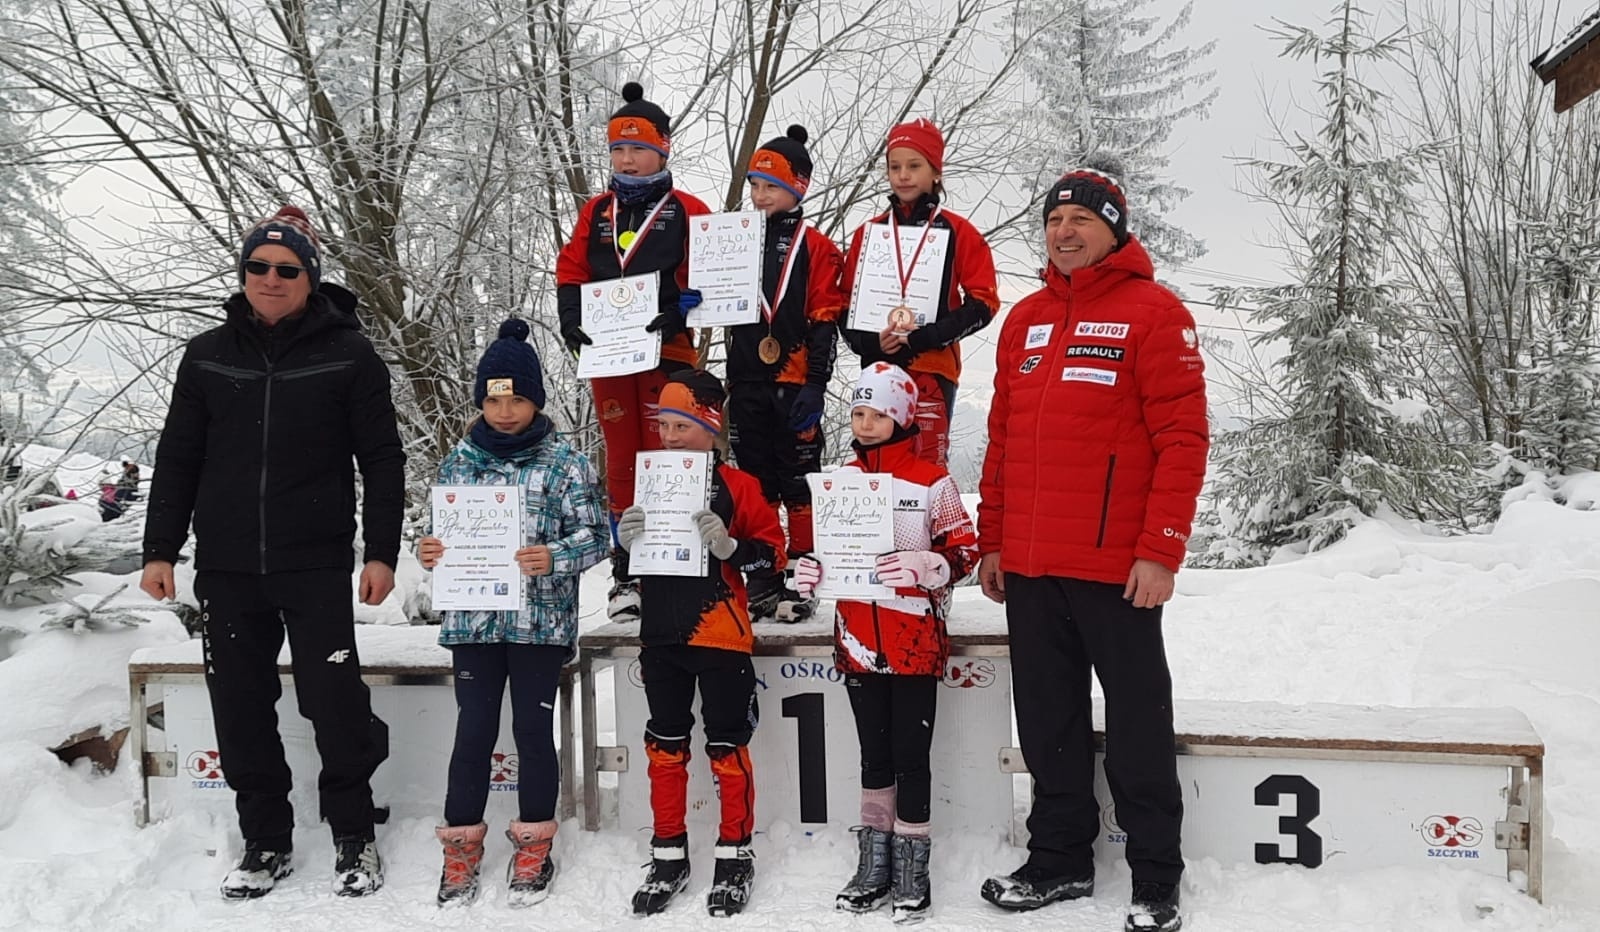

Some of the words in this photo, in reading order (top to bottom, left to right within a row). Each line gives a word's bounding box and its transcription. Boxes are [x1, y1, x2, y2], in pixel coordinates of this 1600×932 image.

[1092, 325, 1126, 336] LOTOS
[1067, 346, 1123, 359] RENAULT
[1020, 356, 1042, 373] 4F
[899, 499, 919, 508] NKS
[203, 599, 215, 674] POLSKA
[327, 649, 350, 663] 4F
[781, 658, 842, 682] OŚRO
[781, 693, 827, 823] 1
[1254, 775, 1322, 868] 3
[1427, 848, 1479, 859] SZCZYRK
